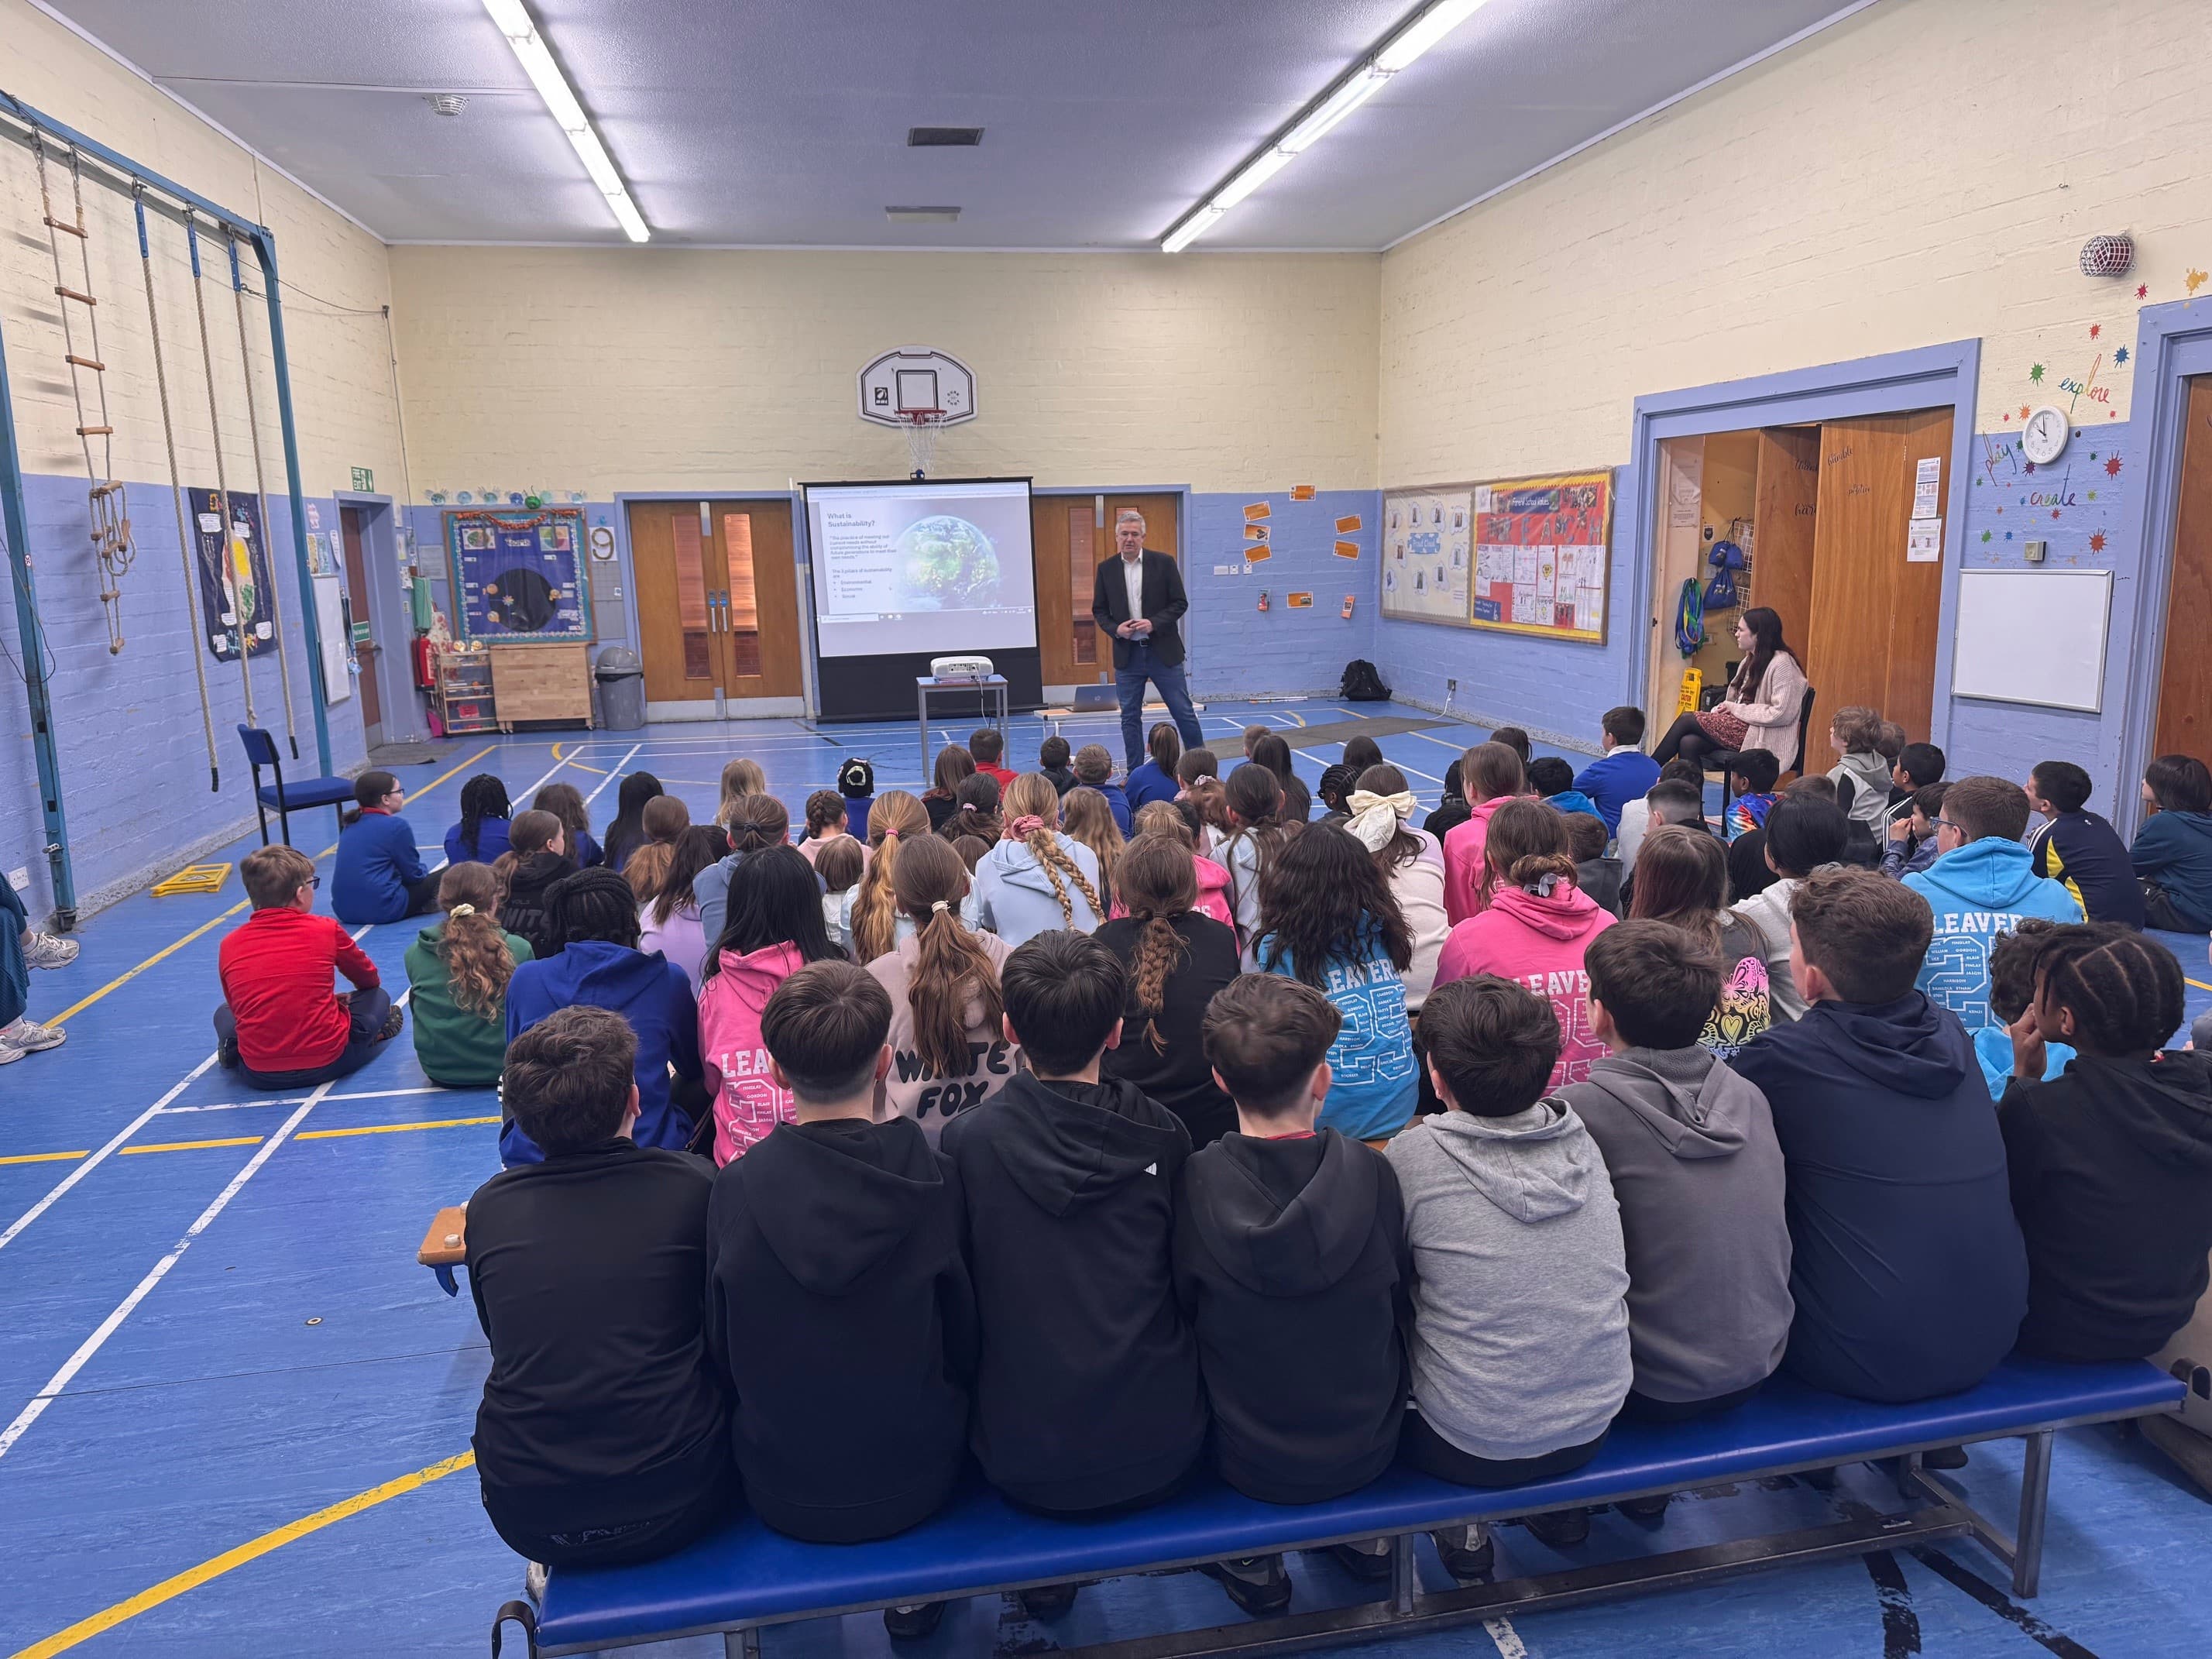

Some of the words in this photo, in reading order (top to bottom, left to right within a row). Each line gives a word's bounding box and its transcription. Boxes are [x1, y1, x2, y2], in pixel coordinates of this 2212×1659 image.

[2058, 354, 2110, 414] explore
[352, 468, 361, 479] FIRE
[1983, 430, 2017, 486] play
[353, 479, 362, 490] EXIT
[2030, 464, 2076, 507] create
[1933, 912, 2034, 935] LEAVER
[1324, 959, 1401, 997] EAVER
[895, 1041, 1012, 1084] WTE
[916, 1080, 989, 1119] FOX
